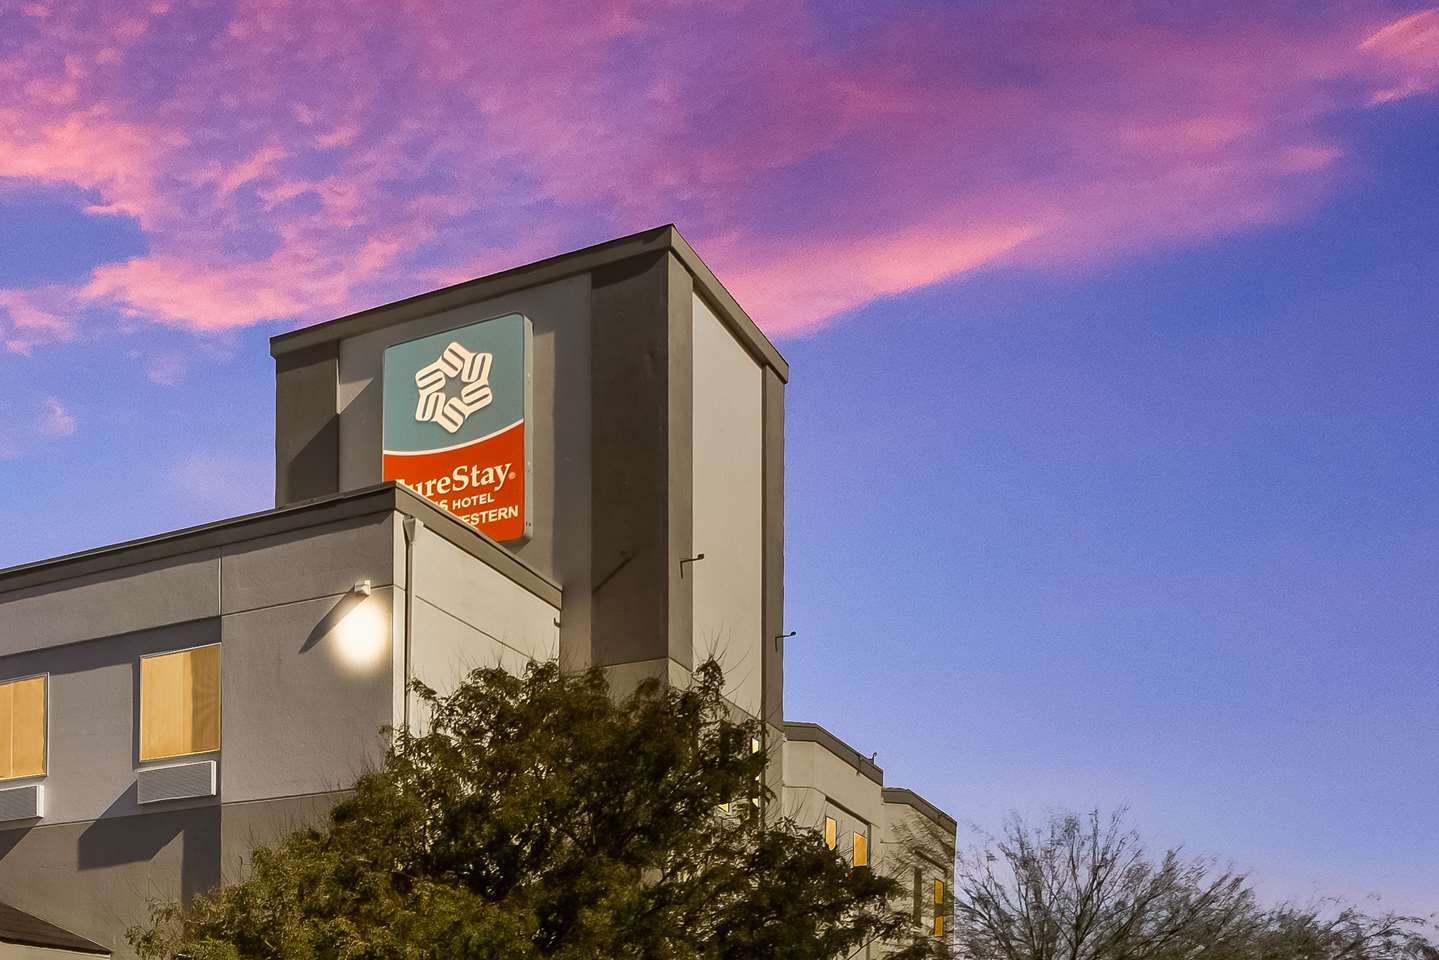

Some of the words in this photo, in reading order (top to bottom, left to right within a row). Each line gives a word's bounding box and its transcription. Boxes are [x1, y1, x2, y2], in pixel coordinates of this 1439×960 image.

[397, 463, 512, 498] ureStay
[452, 492, 496, 511] HOTEL
[459, 505, 520, 526] ESTERN
